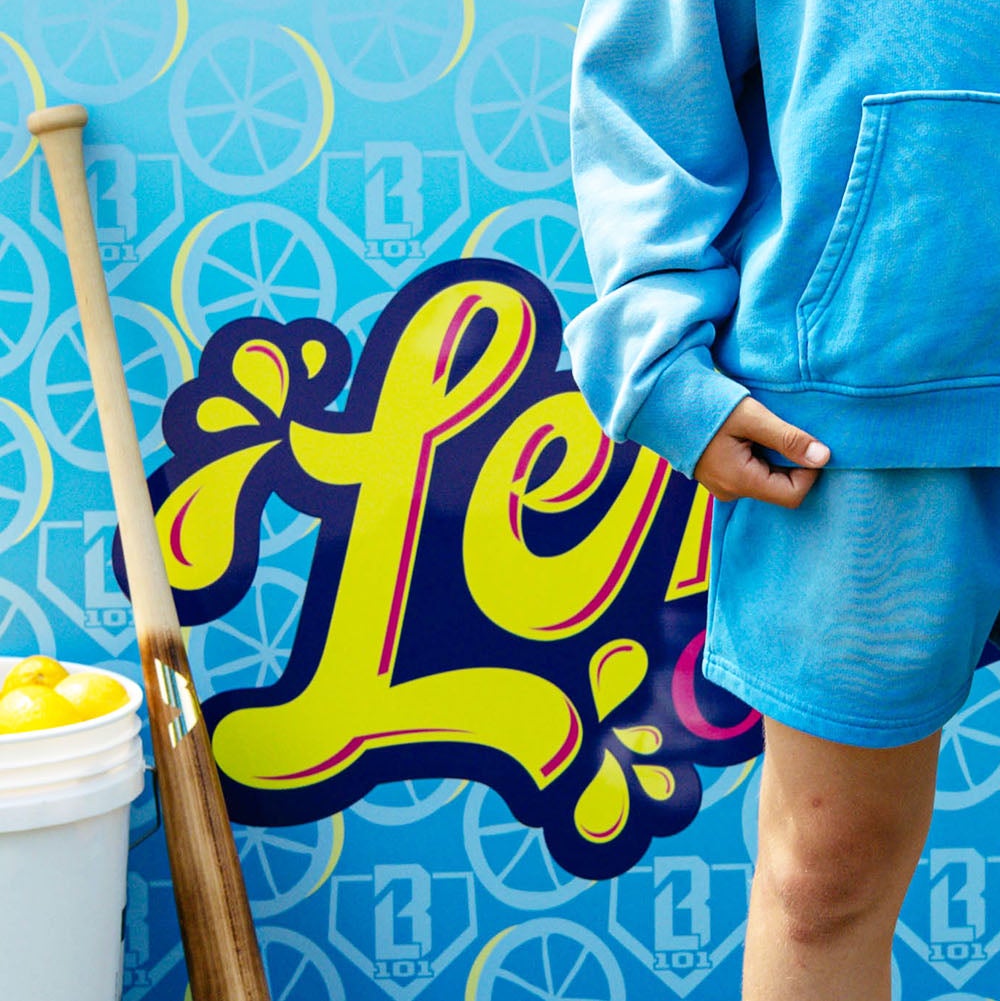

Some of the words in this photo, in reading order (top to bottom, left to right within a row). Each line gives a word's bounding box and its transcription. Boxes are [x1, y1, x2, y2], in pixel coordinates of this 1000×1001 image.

[101, 243, 139, 261] 01
[364, 240, 426, 259] 101
[654, 952, 713, 970] 101
[930, 943, 987, 961] 101
[374, 960, 434, 978] 101
